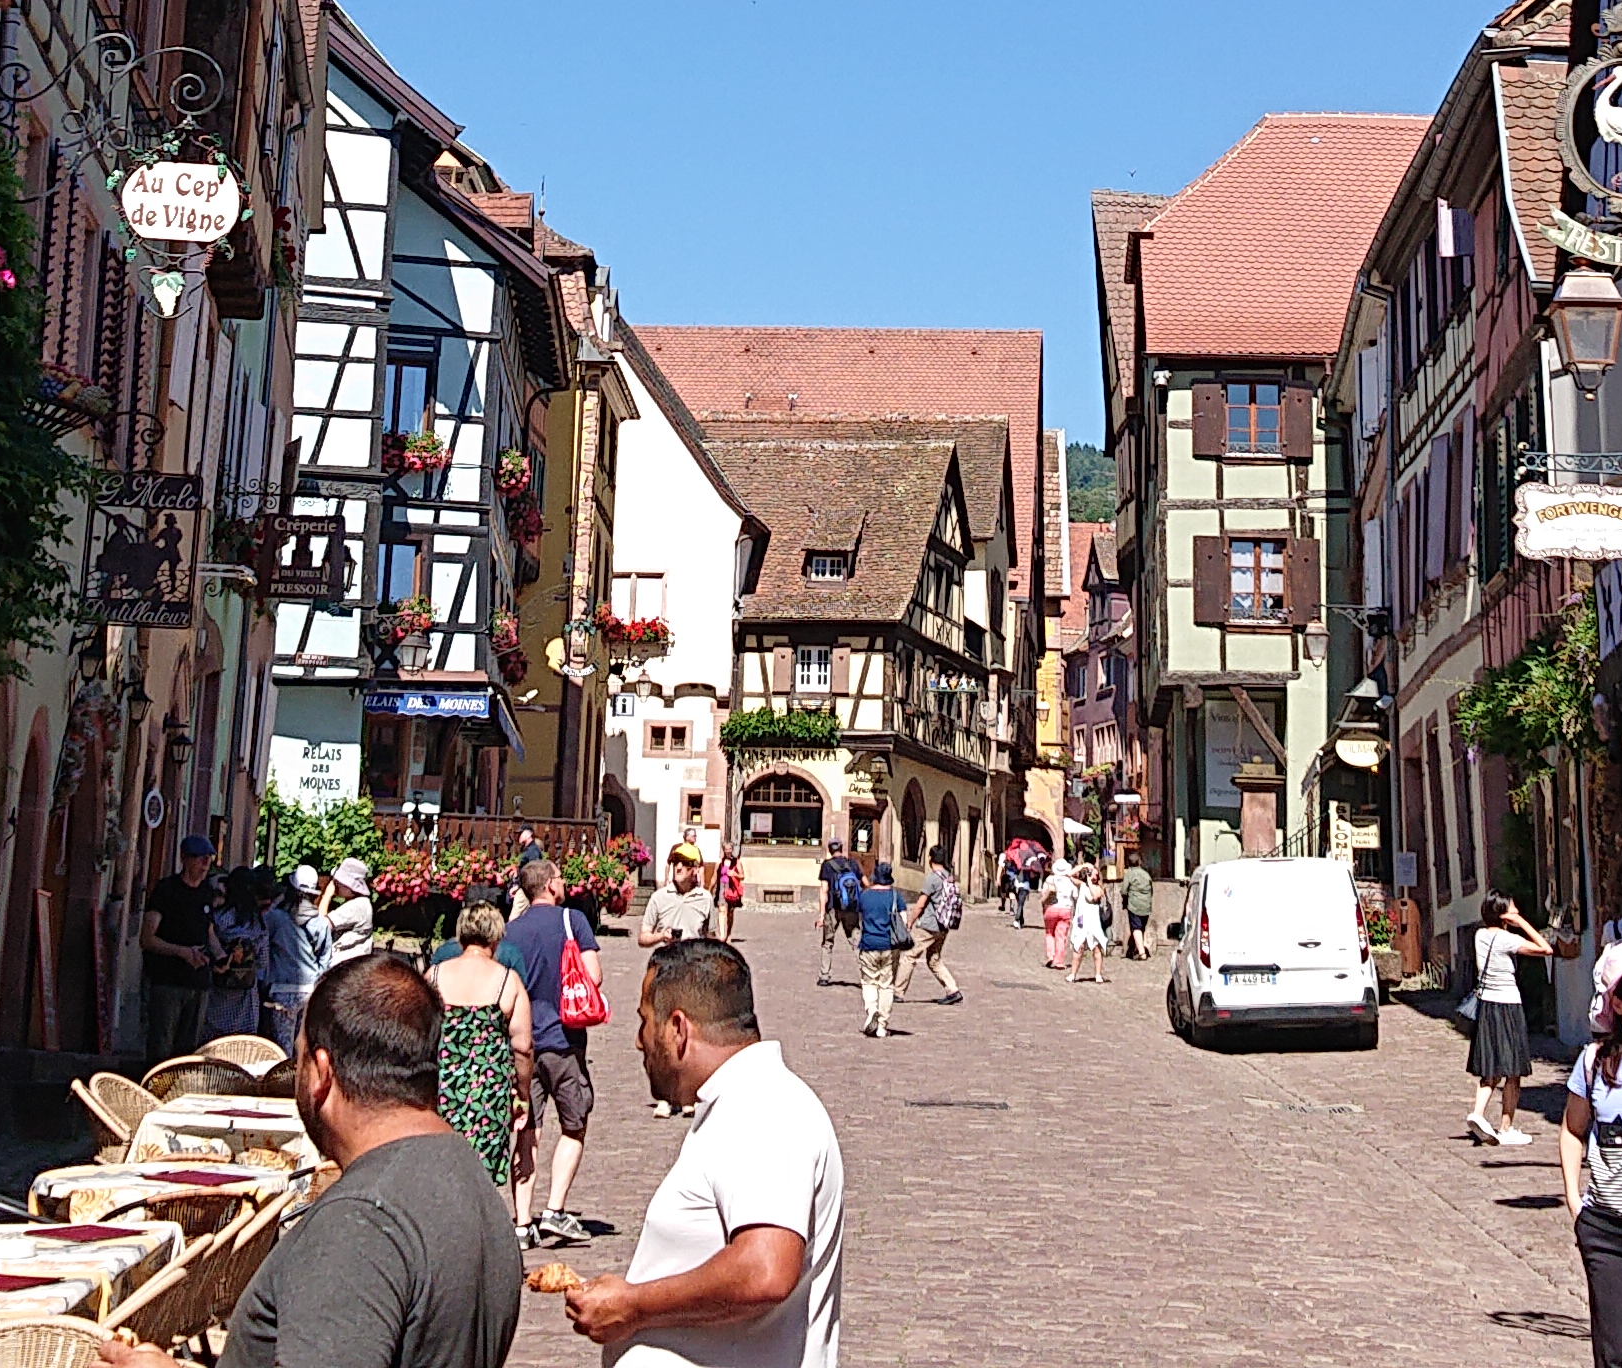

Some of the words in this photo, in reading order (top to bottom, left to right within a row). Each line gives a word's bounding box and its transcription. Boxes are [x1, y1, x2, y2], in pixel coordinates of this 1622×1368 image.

[132, 170, 164, 194] Au
[175, 172, 219, 203] Cep
[131, 202, 157, 226] de
[162, 204, 226, 234] Vigne
[122, 475, 200, 509] Miclo
[274, 517, 337, 535] Crêperie
[280, 569, 294, 577] DU
[295, 569, 322, 578] VIEUX
[270, 583, 328, 595] PRESSOIR
[364, 695, 400, 708] ELAIS
[406, 696, 432, 710] DES
[439, 697, 486, 712] MOINES
[302, 746, 342, 761] RELAIS
[311, 763, 330, 773] DES
[299, 776, 341, 791] MOINES
